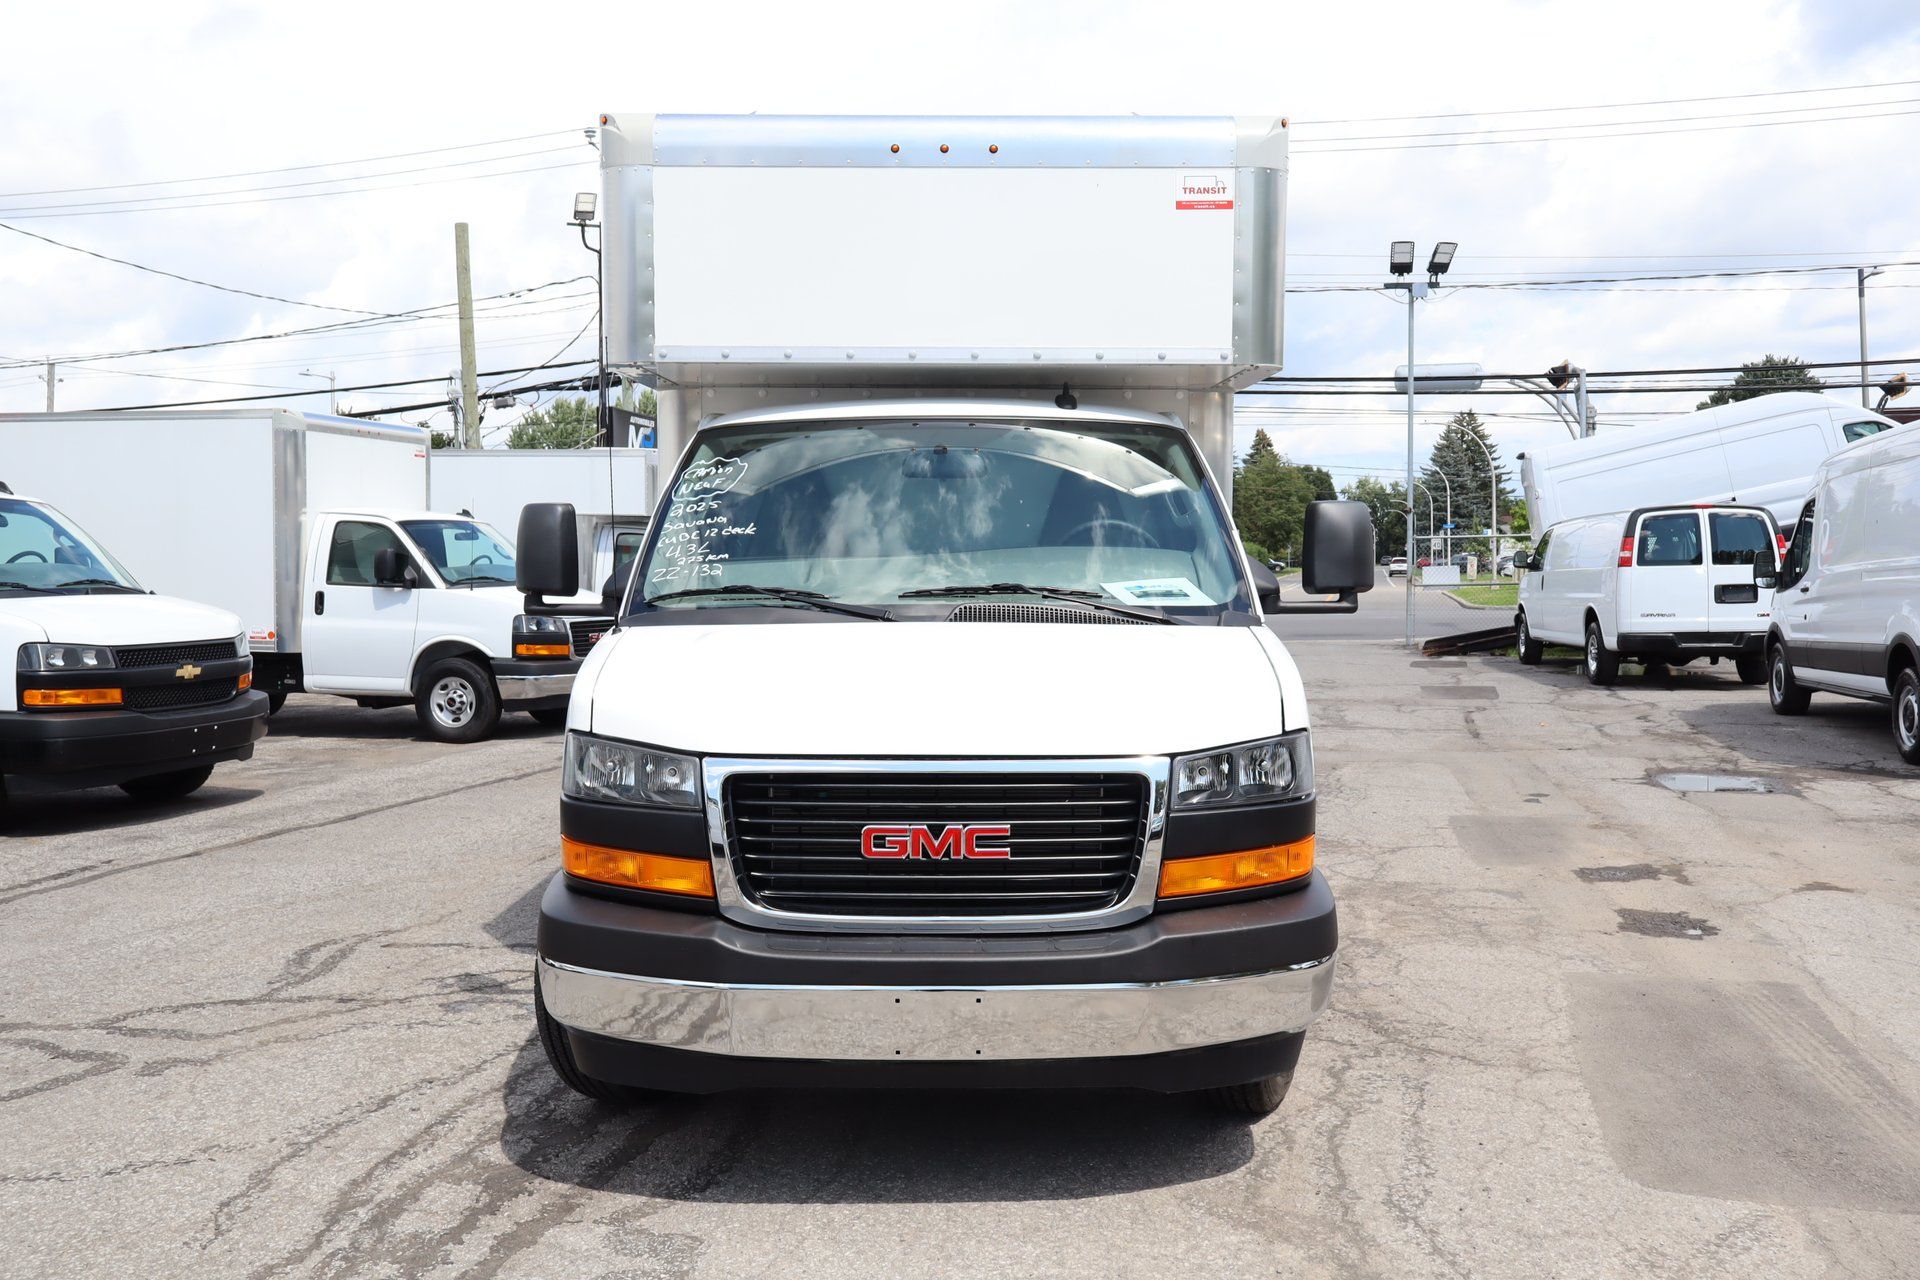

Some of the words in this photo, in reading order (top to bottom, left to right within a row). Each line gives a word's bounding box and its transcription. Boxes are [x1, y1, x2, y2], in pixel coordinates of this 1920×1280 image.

[1182, 187, 1227, 195] TRANSIT
[670, 500, 722, 517] 2025
[704, 528, 718, 537] 12
[721, 522, 757, 535] deck
[861, 824, 1011, 859] GMC
